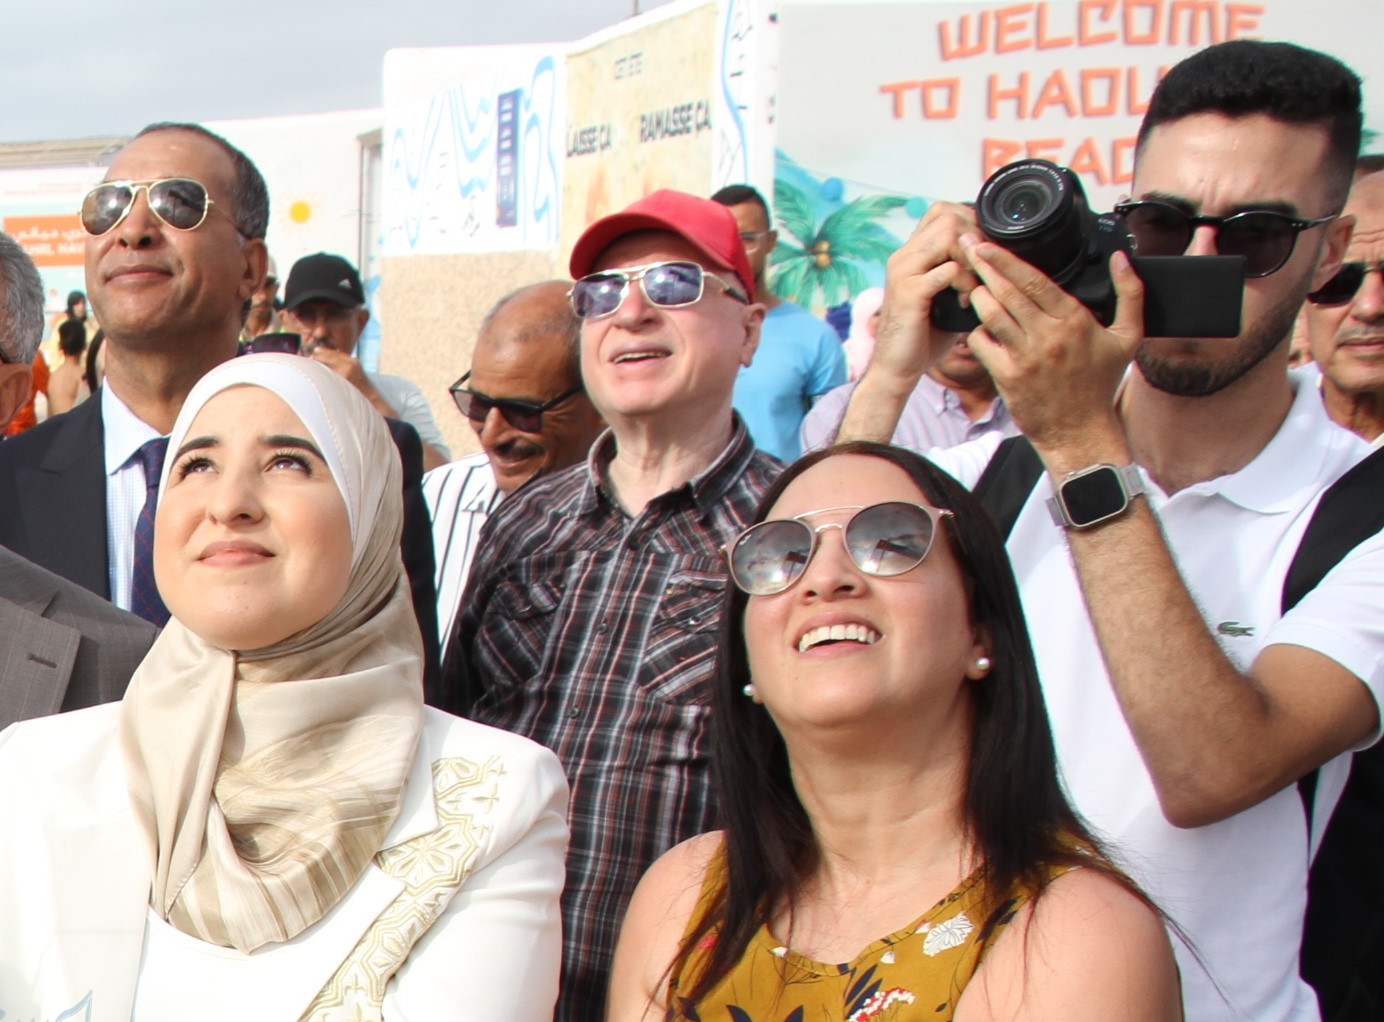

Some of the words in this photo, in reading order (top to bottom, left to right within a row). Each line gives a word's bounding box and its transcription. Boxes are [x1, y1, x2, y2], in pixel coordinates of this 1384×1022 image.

[938, 0, 1265, 61] WELCOME
[879, 77, 961, 119] TO
[987, 65, 1169, 120] HAOU
[639, 103, 693, 143] RAMASSE
[982, 137, 1136, 187] BEAC
